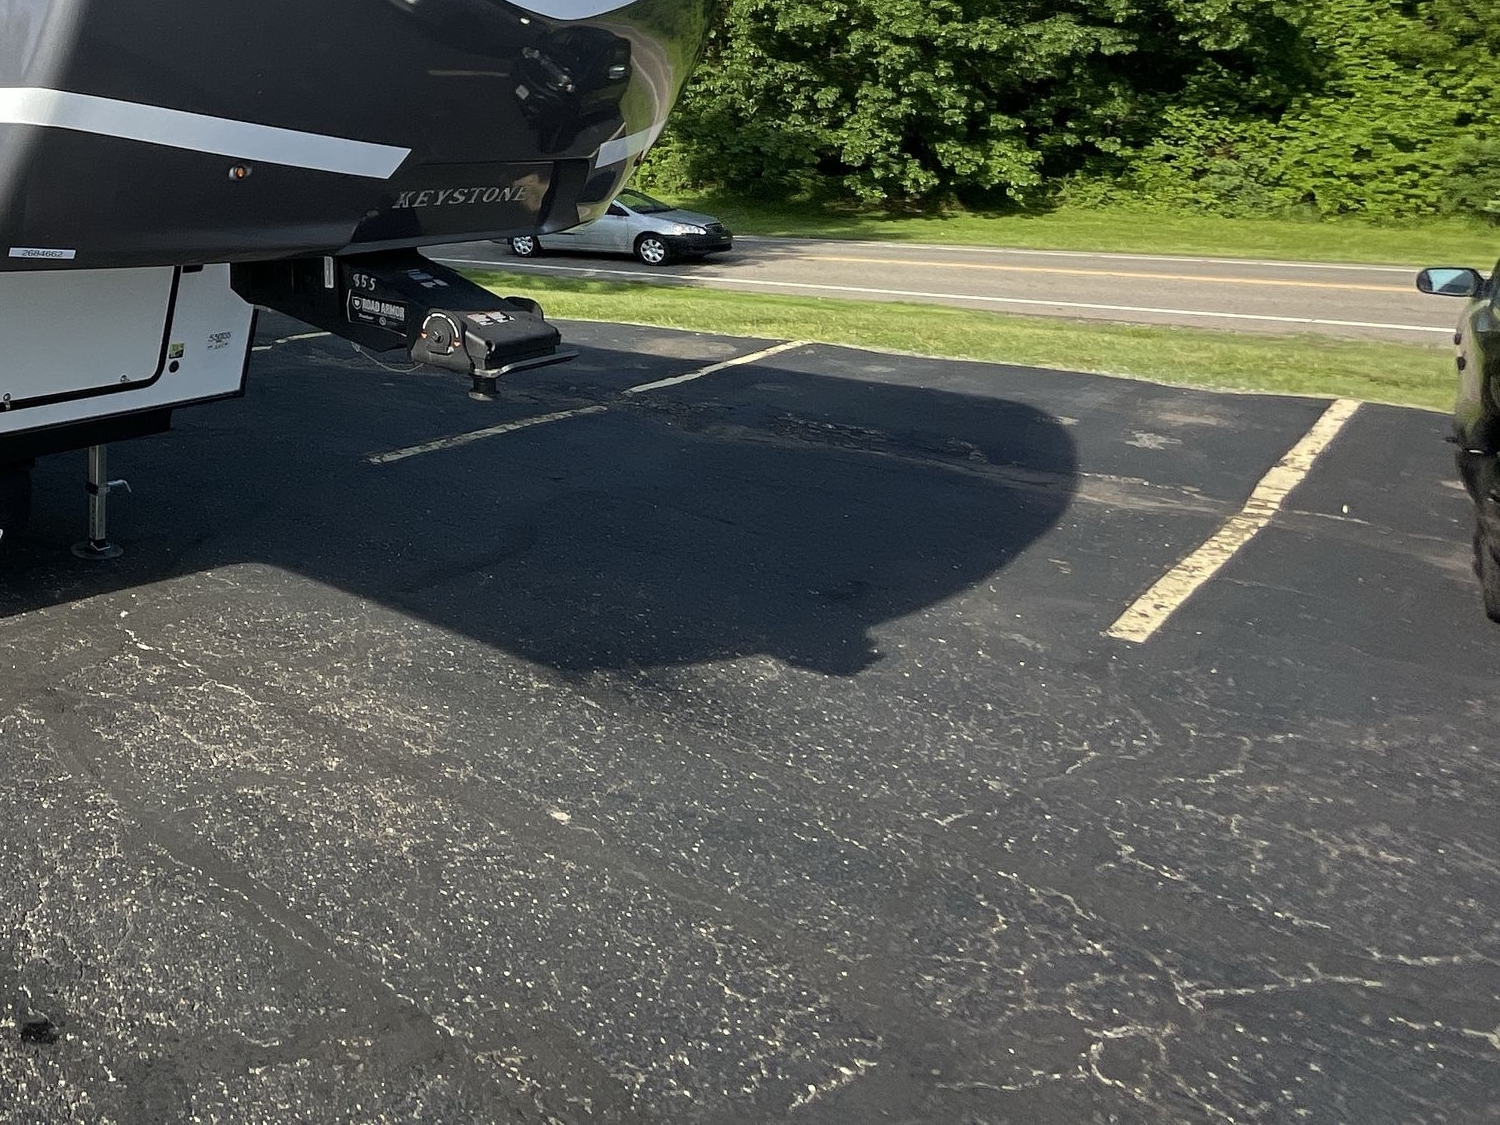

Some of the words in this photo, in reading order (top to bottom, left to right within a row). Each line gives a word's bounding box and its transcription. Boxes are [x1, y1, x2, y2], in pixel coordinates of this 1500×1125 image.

[391, 185, 527, 209] KEYSTONE
[362, 298, 380, 313] ROAD
[380, 302, 405, 321] ARMOR
